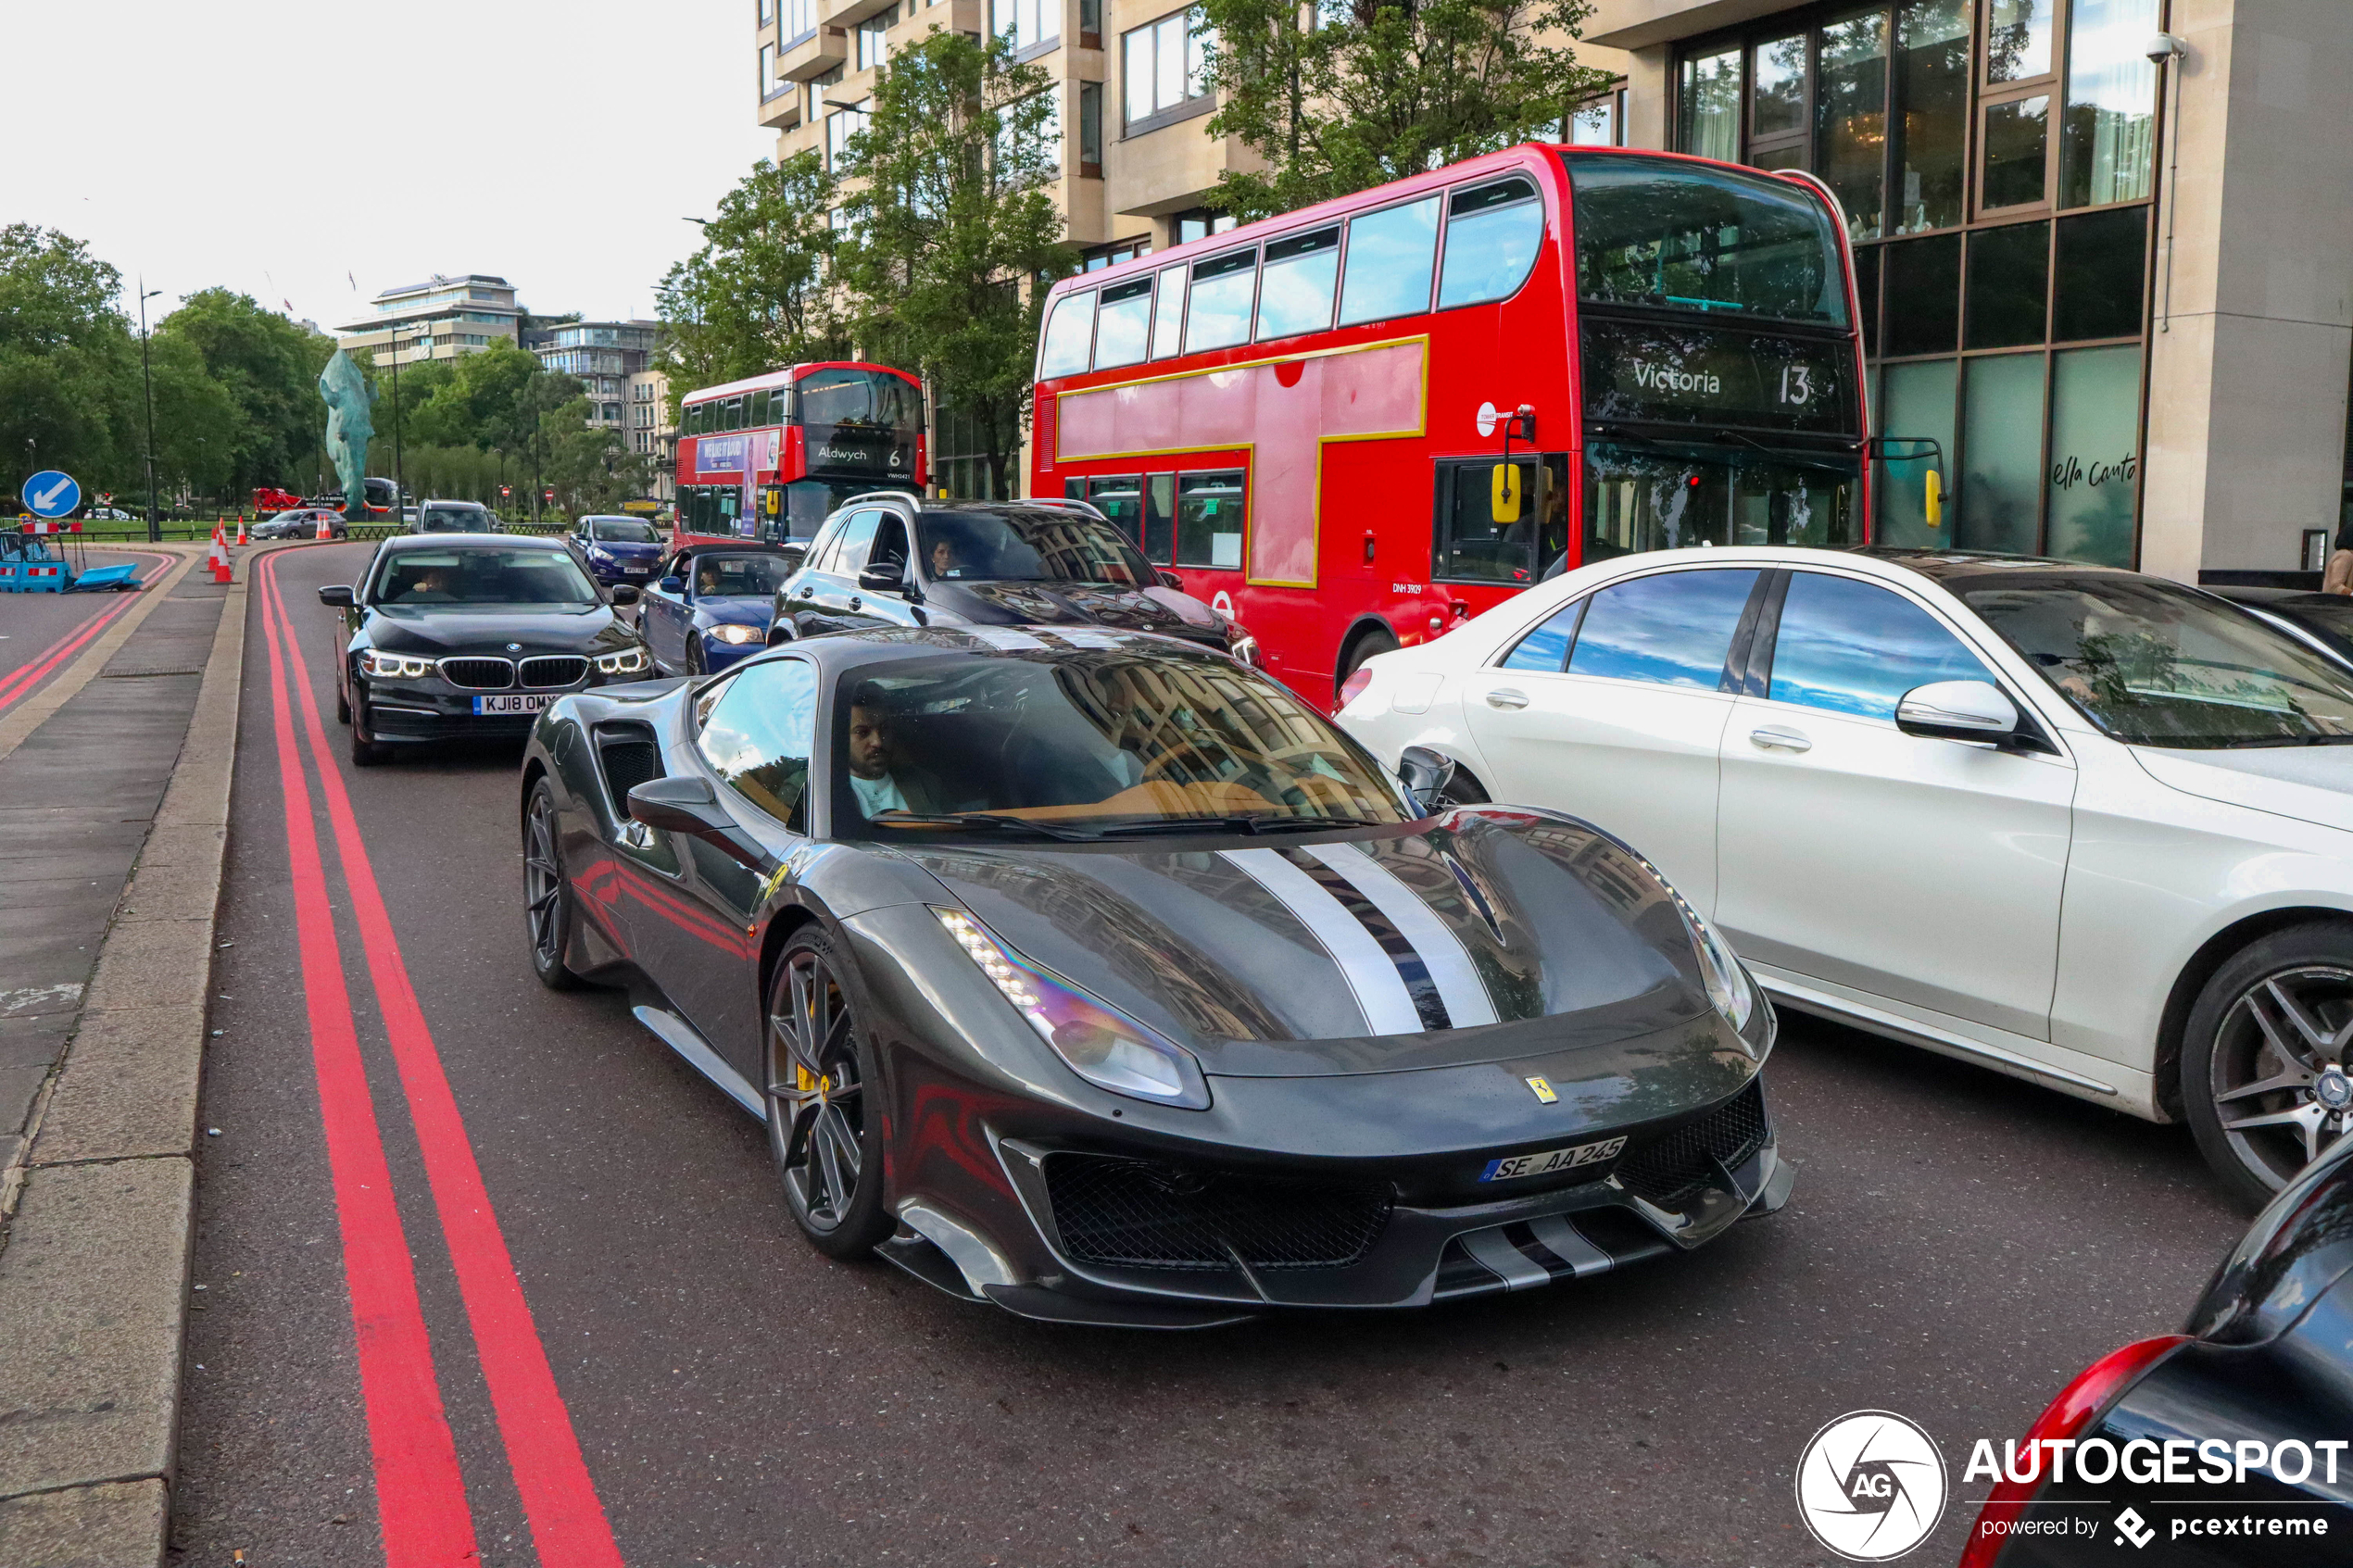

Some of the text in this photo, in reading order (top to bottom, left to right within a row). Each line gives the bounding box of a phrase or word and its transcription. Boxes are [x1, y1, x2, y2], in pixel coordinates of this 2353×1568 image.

[1634, 361, 1810, 405] Victoria 13
[712, 443, 722, 458] LIKE
[818, 446, 900, 467] Aldwych 6
[2054, 456, 2082, 490] ella
[1393, 583, 1406, 593] DNH
[486, 696, 522, 711] KJ18
[1495, 1158, 1532, 1178] SE
[1542, 1149, 1576, 1172] AA
[1576, 1139, 1625, 1165] 245
